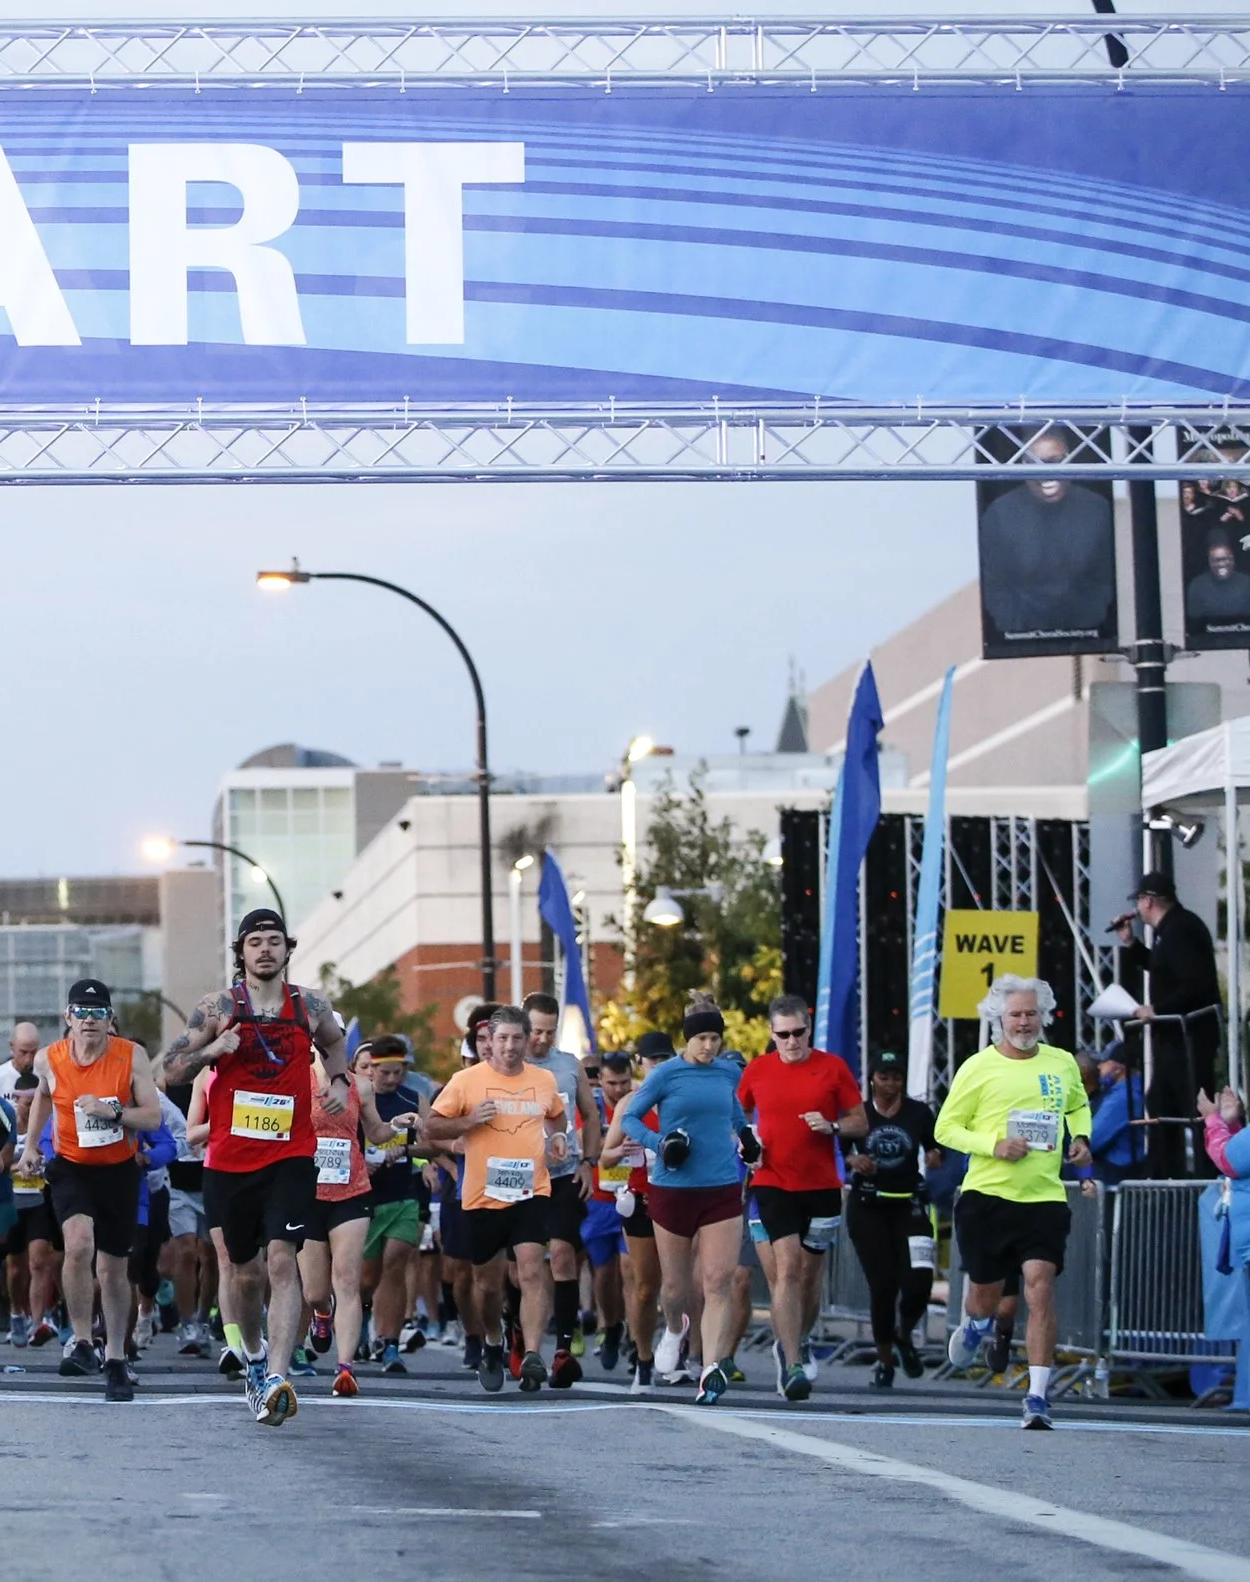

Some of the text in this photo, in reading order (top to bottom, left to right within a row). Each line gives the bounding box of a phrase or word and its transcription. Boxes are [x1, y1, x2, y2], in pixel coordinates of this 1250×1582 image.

[955, 934, 1025, 954] WAVE
[980, 961, 994, 988] 1
[245, 1114, 280, 1132] 1186
[494, 1177, 525, 1189] 4409
